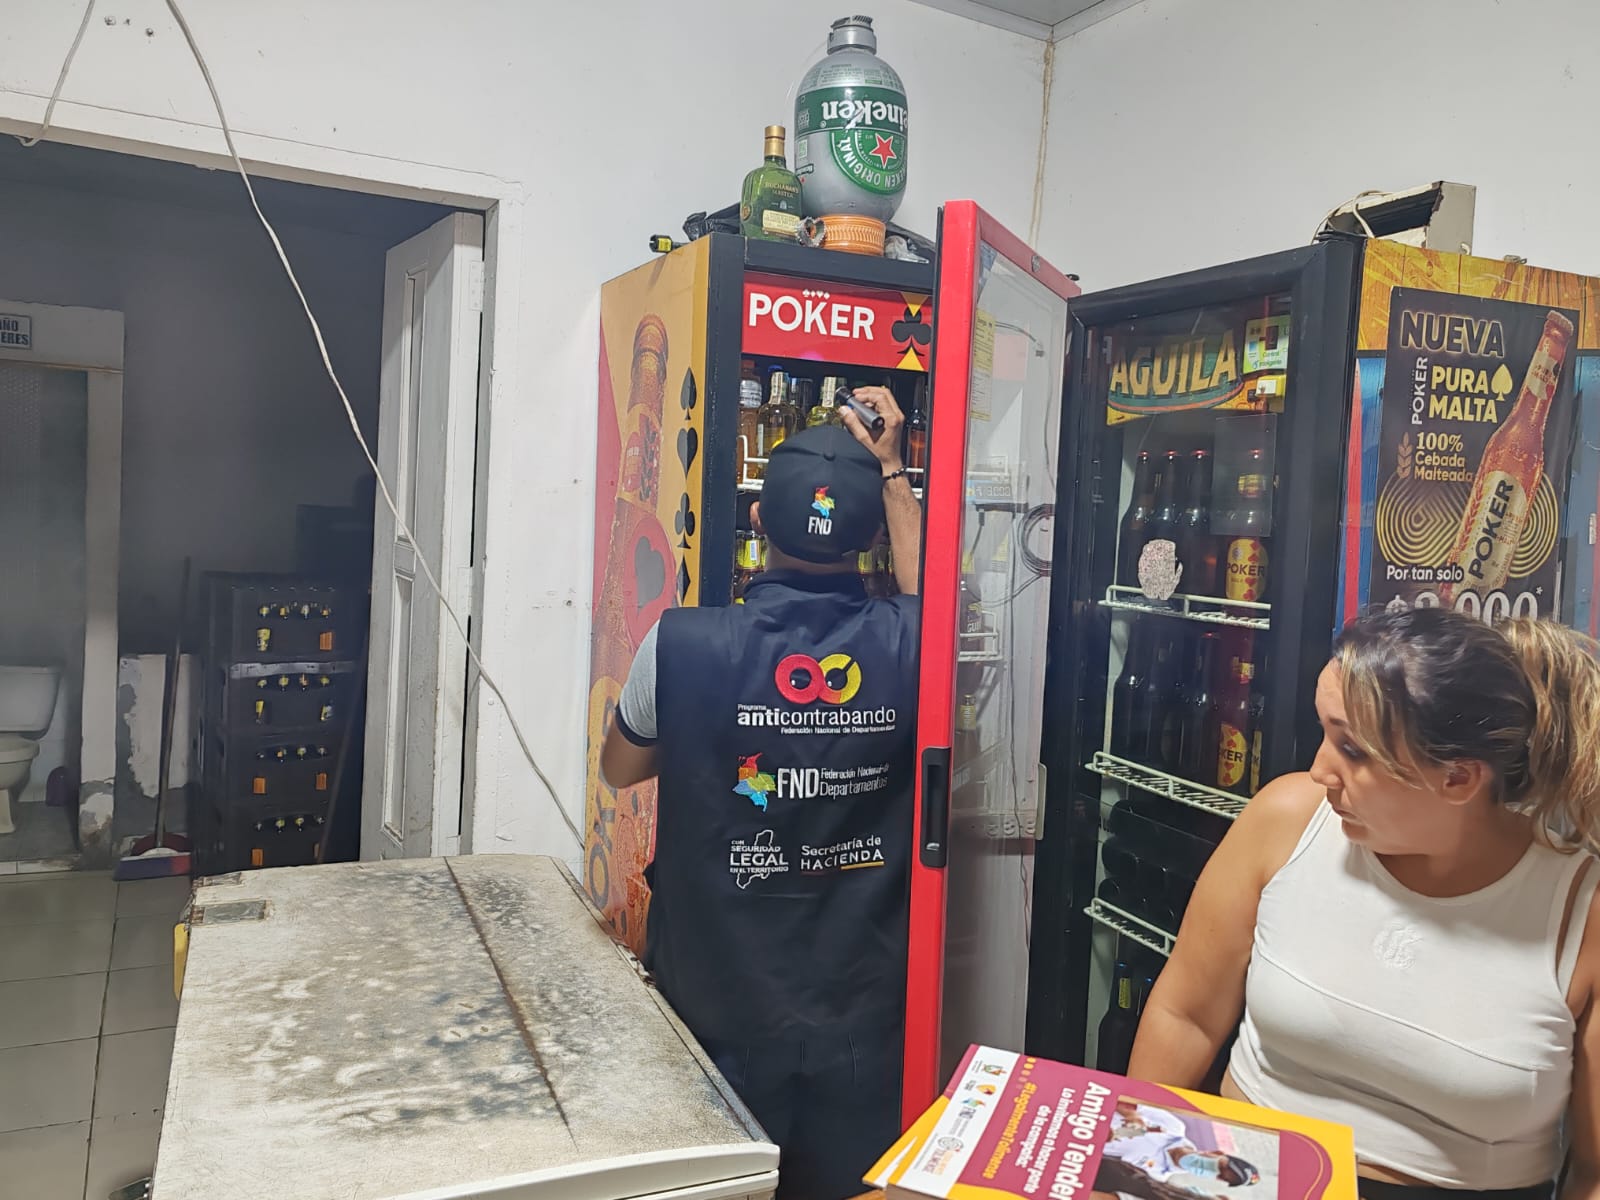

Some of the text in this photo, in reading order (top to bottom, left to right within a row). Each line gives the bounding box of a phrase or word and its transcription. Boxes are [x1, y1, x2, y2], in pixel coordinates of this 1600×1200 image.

[748, 292, 875, 341] POKER
[1400, 310, 1505, 358] NUEVA
[1110, 329, 1237, 396] AGUILA
[1411, 356, 1429, 425] POKER
[1431, 365, 1489, 395] PURA
[1428, 394, 1498, 424] MALTA
[1416, 432, 1464, 452] 100%
[1414, 451, 1466, 468] Cebada
[1414, 466, 1474, 482] Malteada
[807, 515, 833, 536] FND
[1468, 479, 1514, 580] POKER
[1386, 565, 1465, 581] Por tan solo
[737, 706, 896, 726] anticontrabando
[777, 767, 819, 799] FND
[820, 767, 856, 780] Federación
[819, 776, 888, 800] Departamentos
[730, 845, 782, 853] SEGURIDAD
[801, 834, 882, 857] Secretaría de
[729, 852, 789, 866] LEGAL
[800, 849, 884, 870] HACIENDA
[1032, 1116, 1048, 1127] la
[1035, 1104, 1052, 1117] de
[1045, 1097, 1073, 1140] invitamos
[1067, 1081, 1112, 1140] Amigo
[982, 1082, 1038, 1180] #LegalmenteTolimense
[1042, 1138, 1055, 1147] a
[1033, 1145, 1056, 1170] hacer
[1022, 1167, 1045, 1194] parte
